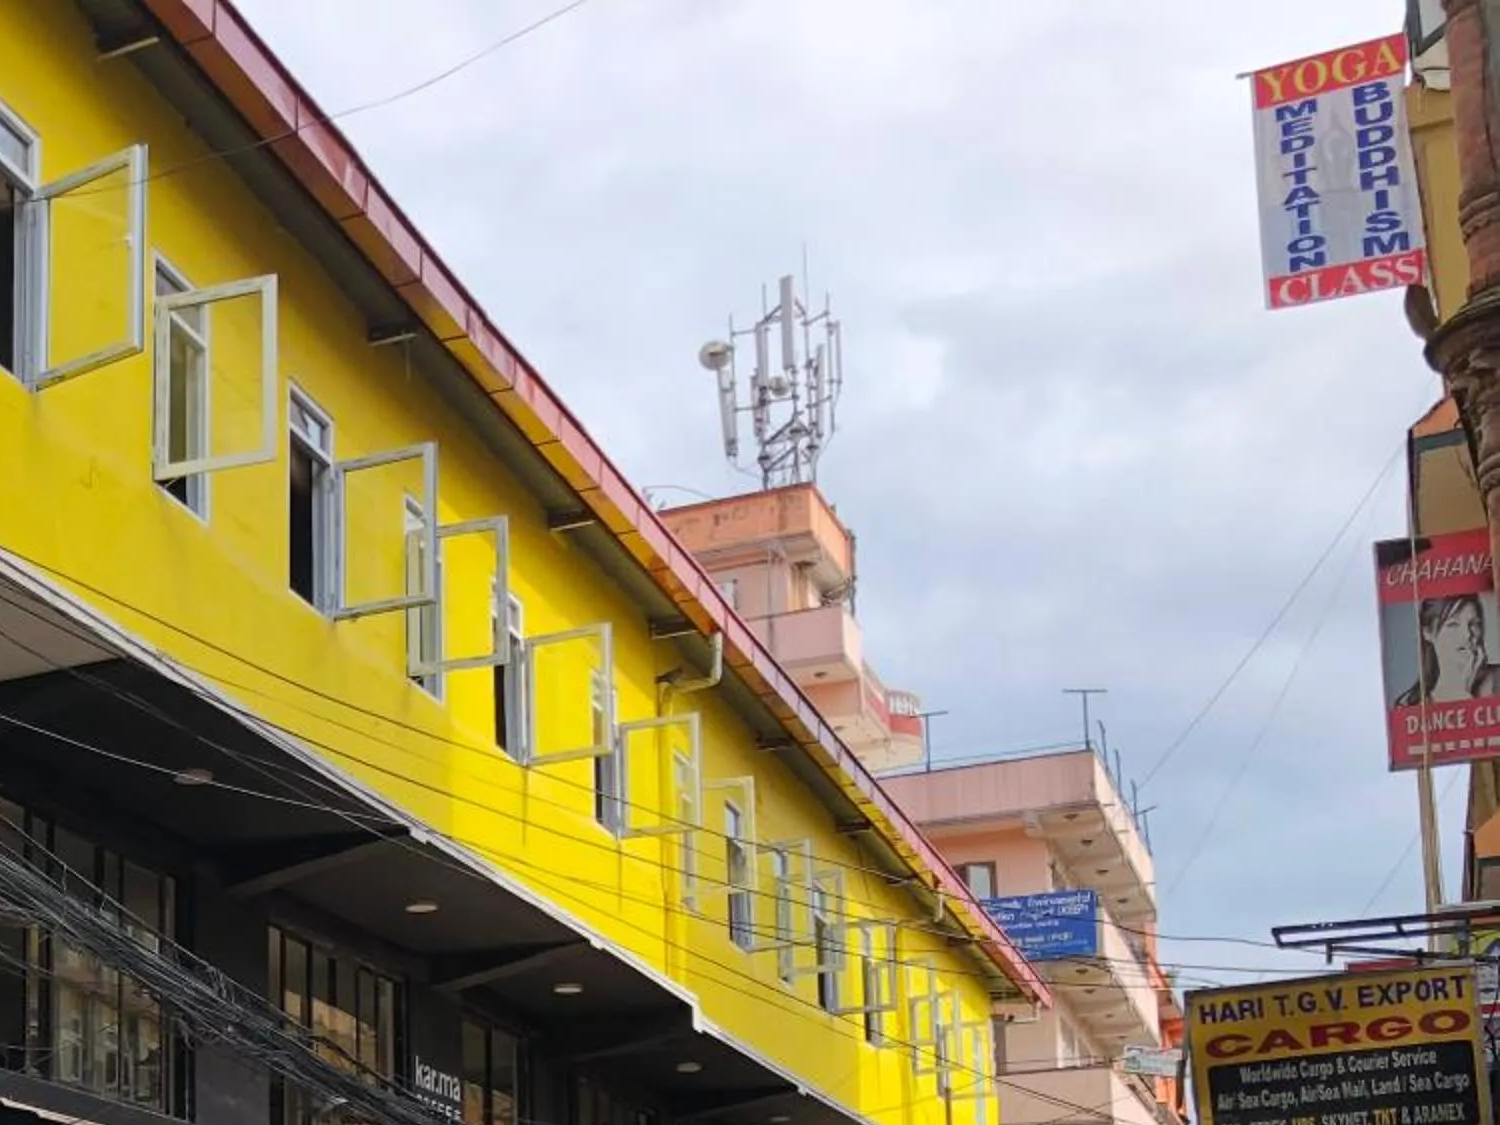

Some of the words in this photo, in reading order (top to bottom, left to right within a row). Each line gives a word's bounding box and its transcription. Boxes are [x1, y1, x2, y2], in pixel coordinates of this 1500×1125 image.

[1259, 42, 1401, 103] YOGA
[1275, 99, 1325, 273] MEDITATION
[1352, 82, 1409, 257] BUDDHISM
[1280, 256, 1419, 305] CLASS
[1473, 705, 1500, 726] CL
[1200, 1000, 1264, 1025] HARI
[1357, 975, 1468, 1008] EXPORT
[1206, 1009, 1471, 1059] CARGO
[1239, 1064, 1298, 1084] Worldwide
[1300, 1060, 1334, 1081] Cargo
[1336, 1057, 1345, 1075] &
[1348, 1053, 1389, 1072] Courier
[1392, 1049, 1437, 1068] Service
[1434, 1071, 1470, 1092] Cargo
[1401, 1106, 1412, 1124] &
[1414, 1102, 1466, 1124] ARAMEX
